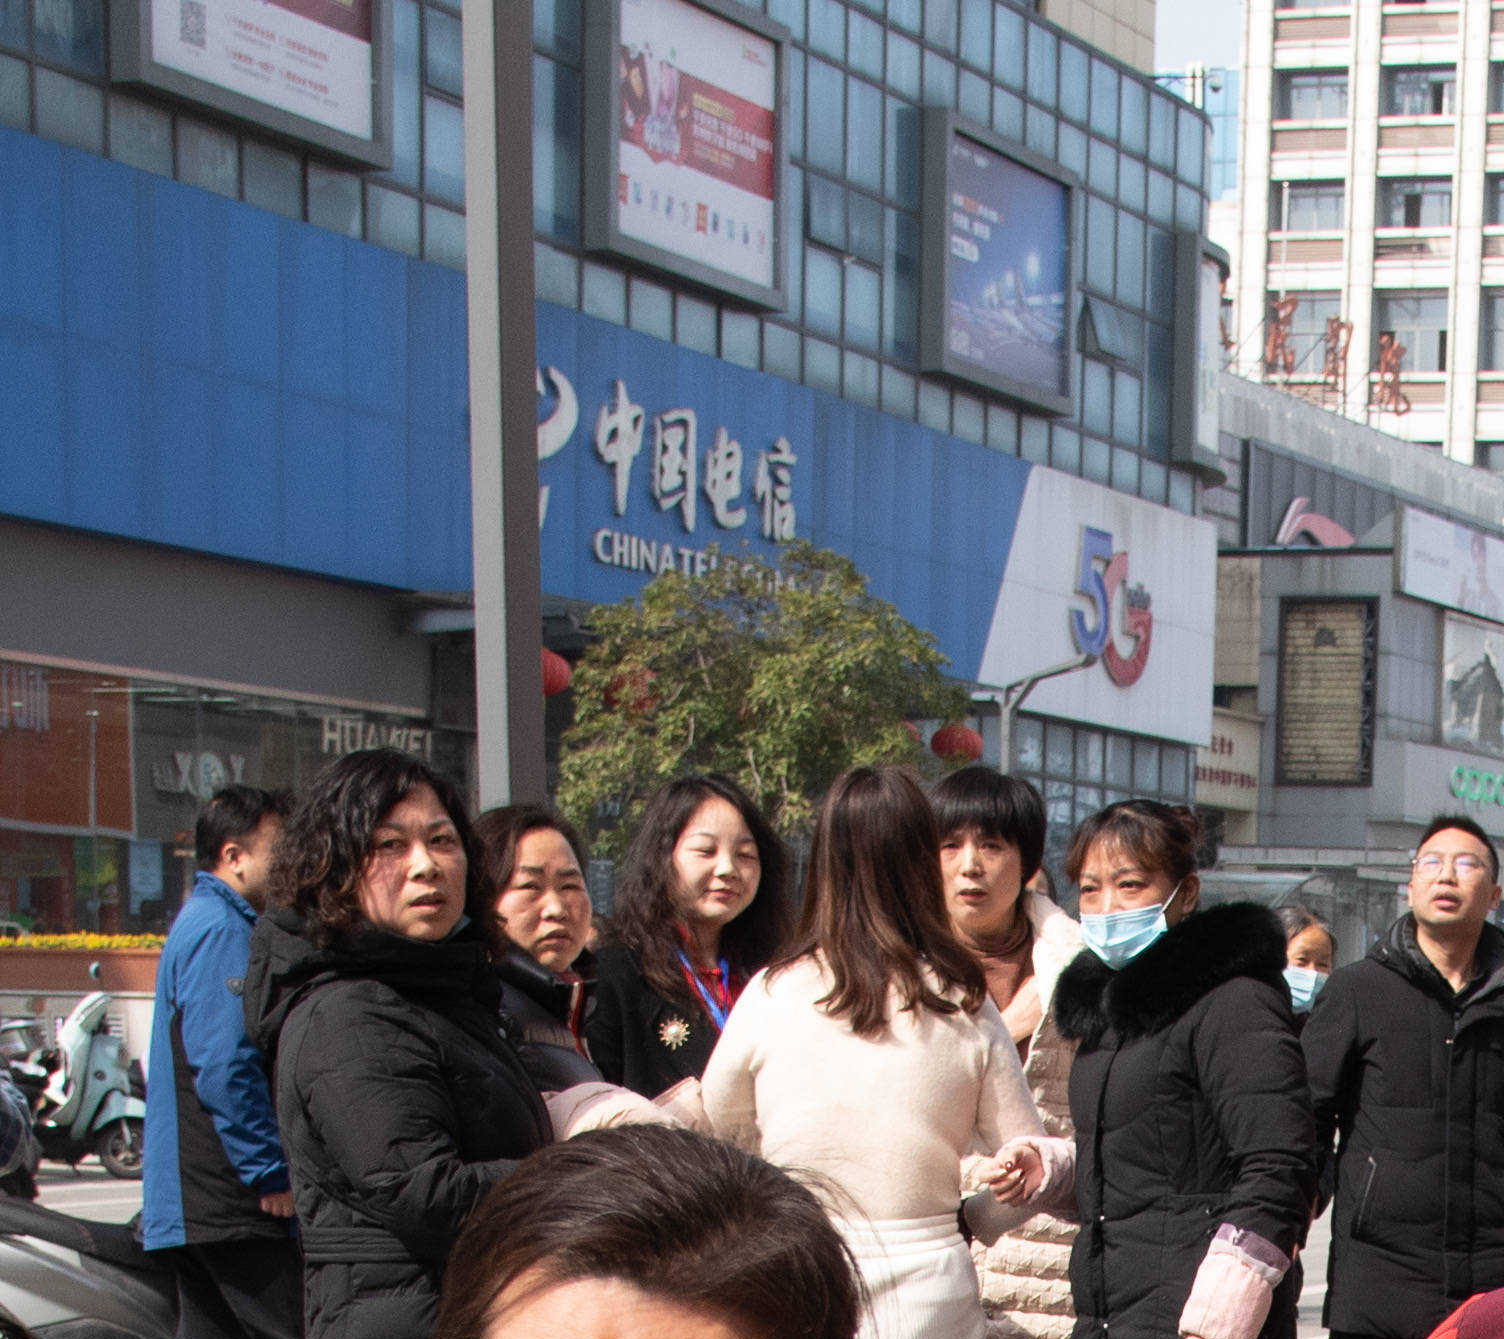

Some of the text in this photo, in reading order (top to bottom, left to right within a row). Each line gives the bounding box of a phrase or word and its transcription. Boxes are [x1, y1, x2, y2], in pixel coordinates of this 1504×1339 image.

[595, 378, 796, 542] 中国电信
[594, 527, 676, 576] CHINA
[1069, 525, 1153, 688] 5G
[321, 716, 433, 761] HUAWEI
